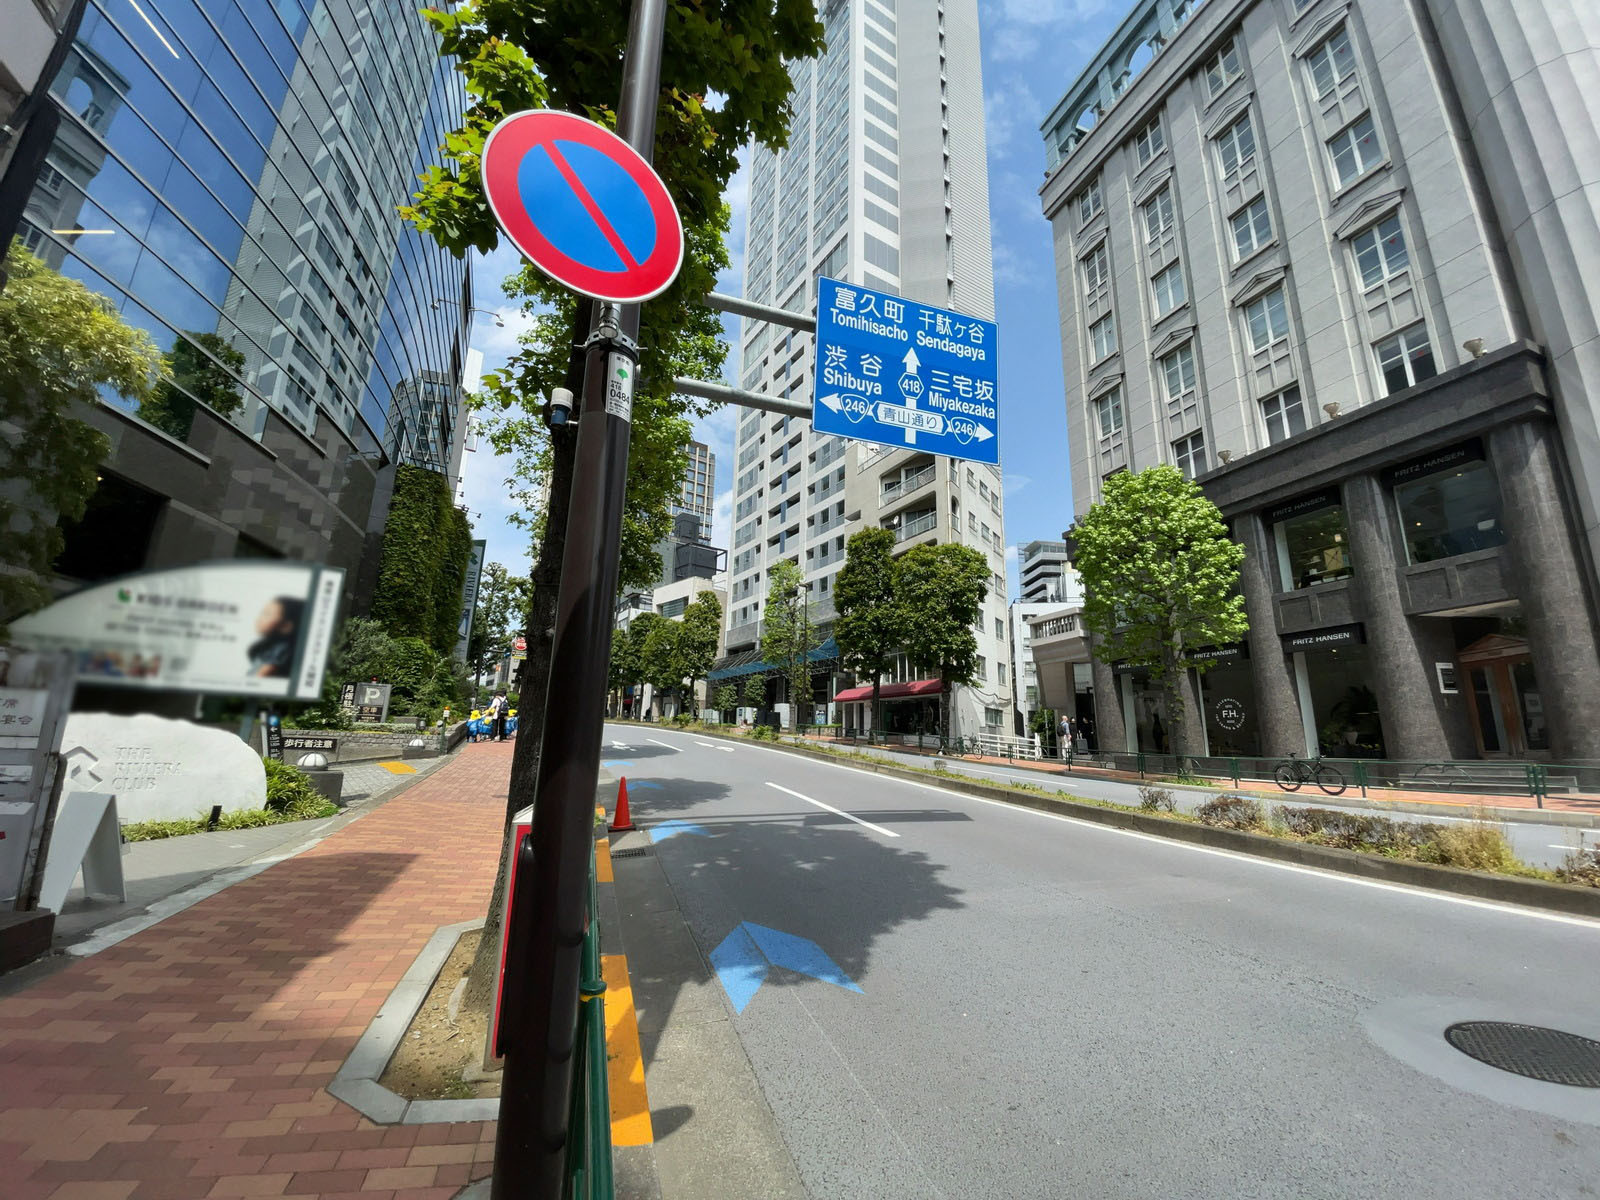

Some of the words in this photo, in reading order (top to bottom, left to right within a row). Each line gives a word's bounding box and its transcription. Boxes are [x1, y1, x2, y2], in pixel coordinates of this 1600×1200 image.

[835, 287, 905, 324] 富久町
[830, 308, 908, 342] Tomihisacho
[916, 331, 985, 361] Sendagaya
[825, 344, 883, 377] 渋谷
[823, 368, 882, 396] Shibuya
[902, 379, 920, 392] 418
[931, 370, 995, 403] 三宅坂
[845, 398, 866, 413] 246
[929, 391, 995, 419] Miyakezaka
[882, 408, 937, 430] 青山通り
[954, 421, 973, 436] 246
[1394, 465, 1421, 478] FRITZ
[1423, 450, 1465, 468] HANSEN
[1294, 495, 1327, 511] HANSEN
[1292, 637, 1314, 646] FRITZ
[1315, 632, 1350, 643] HANSEN
[1212, 648, 1238, 657] HANSEN
[115, 746, 153, 761] THE
[284, 739, 333, 749] 歩行者注意
